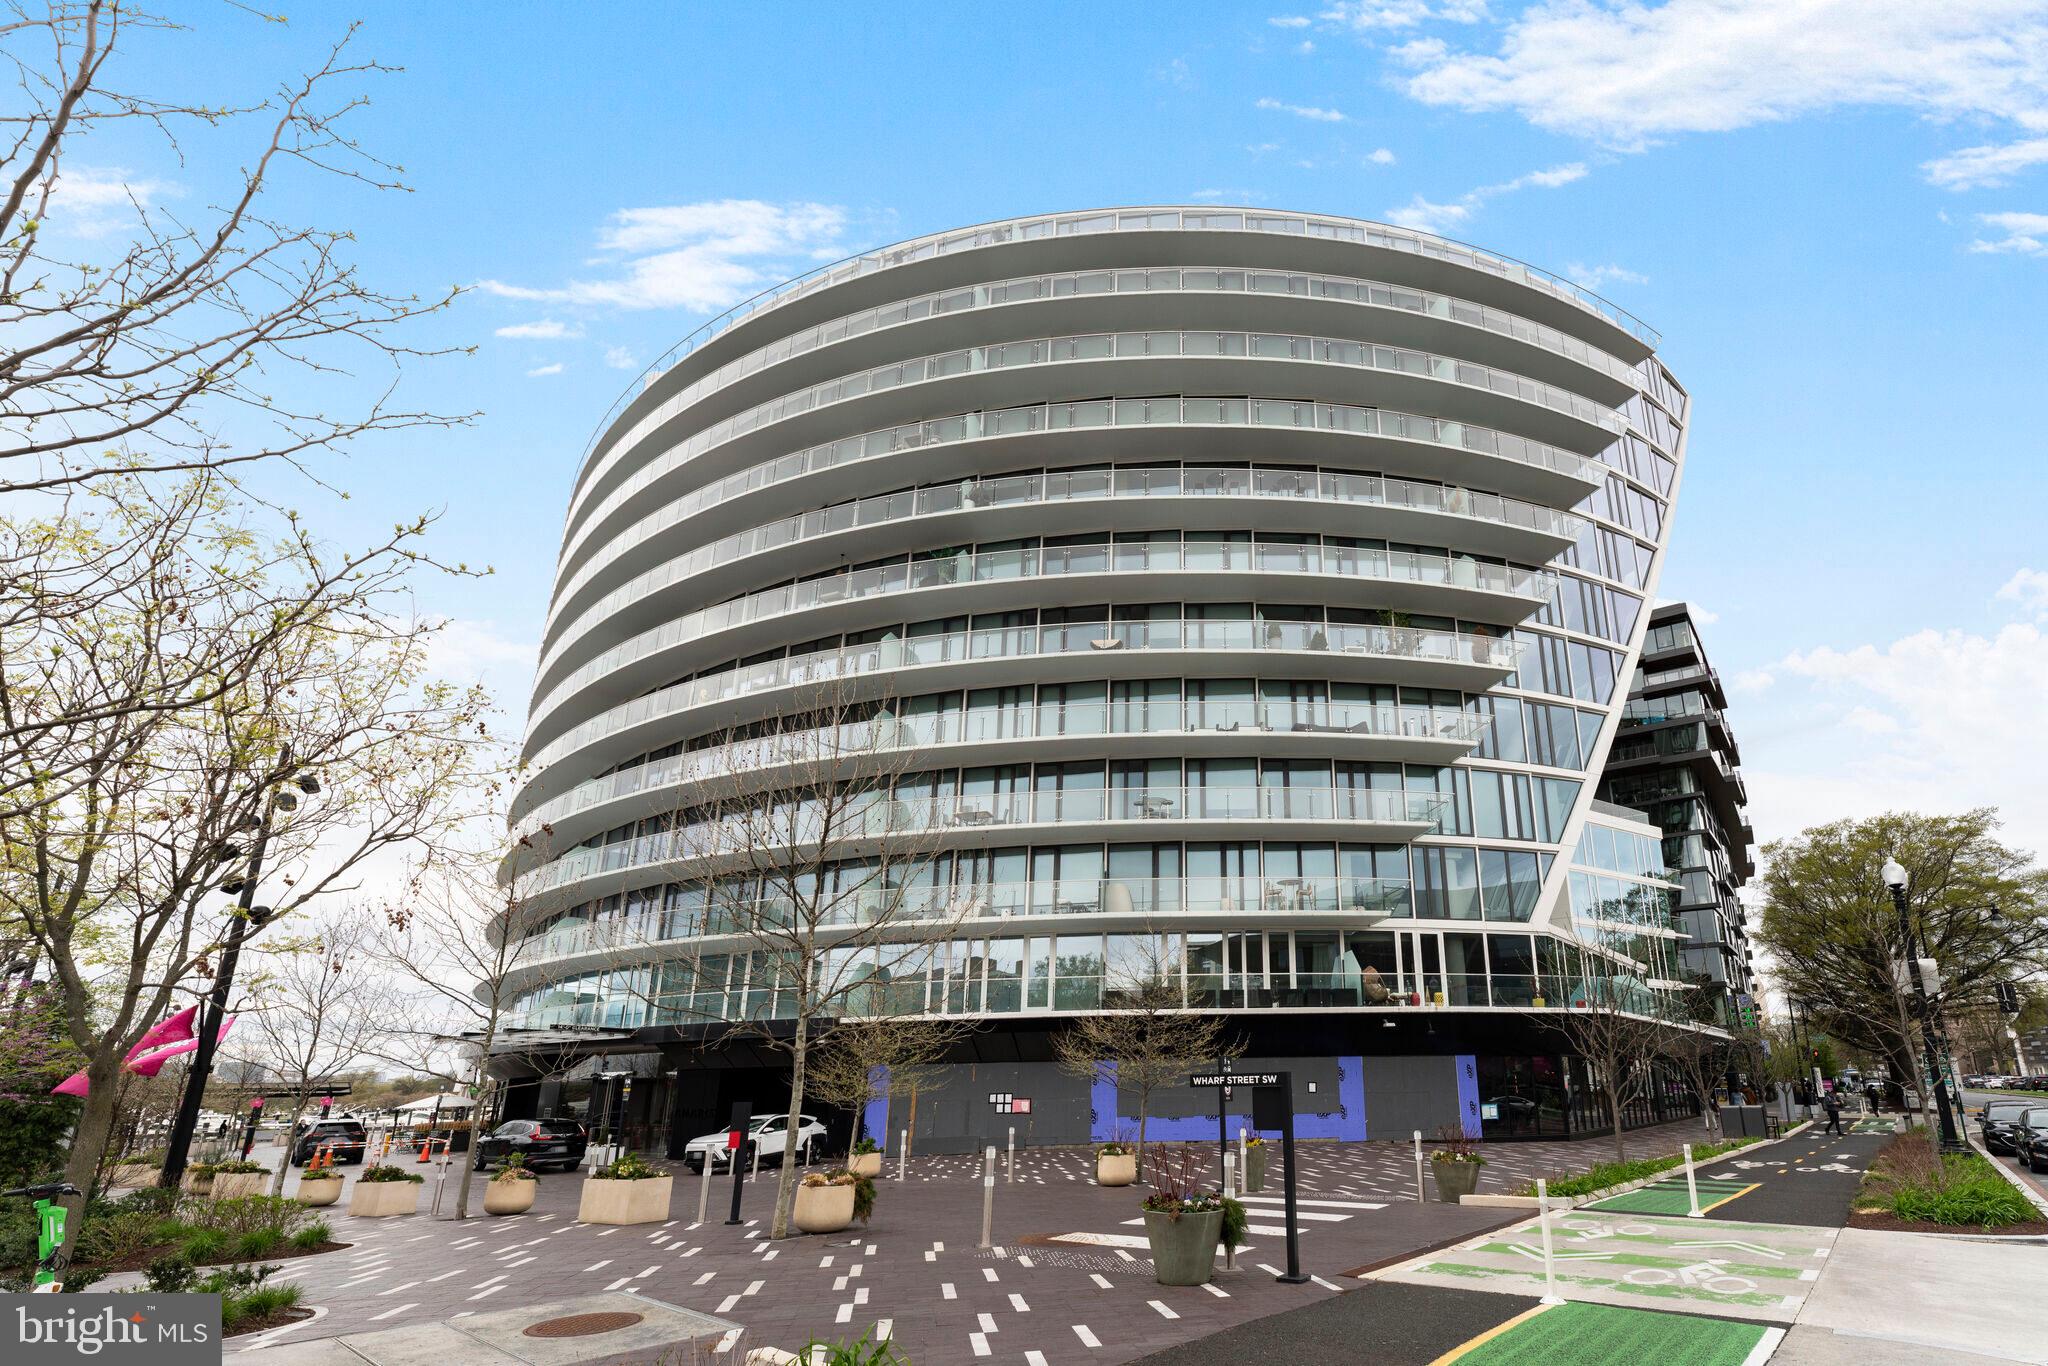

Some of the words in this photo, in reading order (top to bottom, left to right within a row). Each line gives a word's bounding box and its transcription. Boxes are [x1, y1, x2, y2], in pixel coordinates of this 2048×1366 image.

[1193, 1076, 1225, 1085] WHARF
[1227, 1075, 1260, 1084] STREET
[1262, 1075, 1278, 1084] SW
